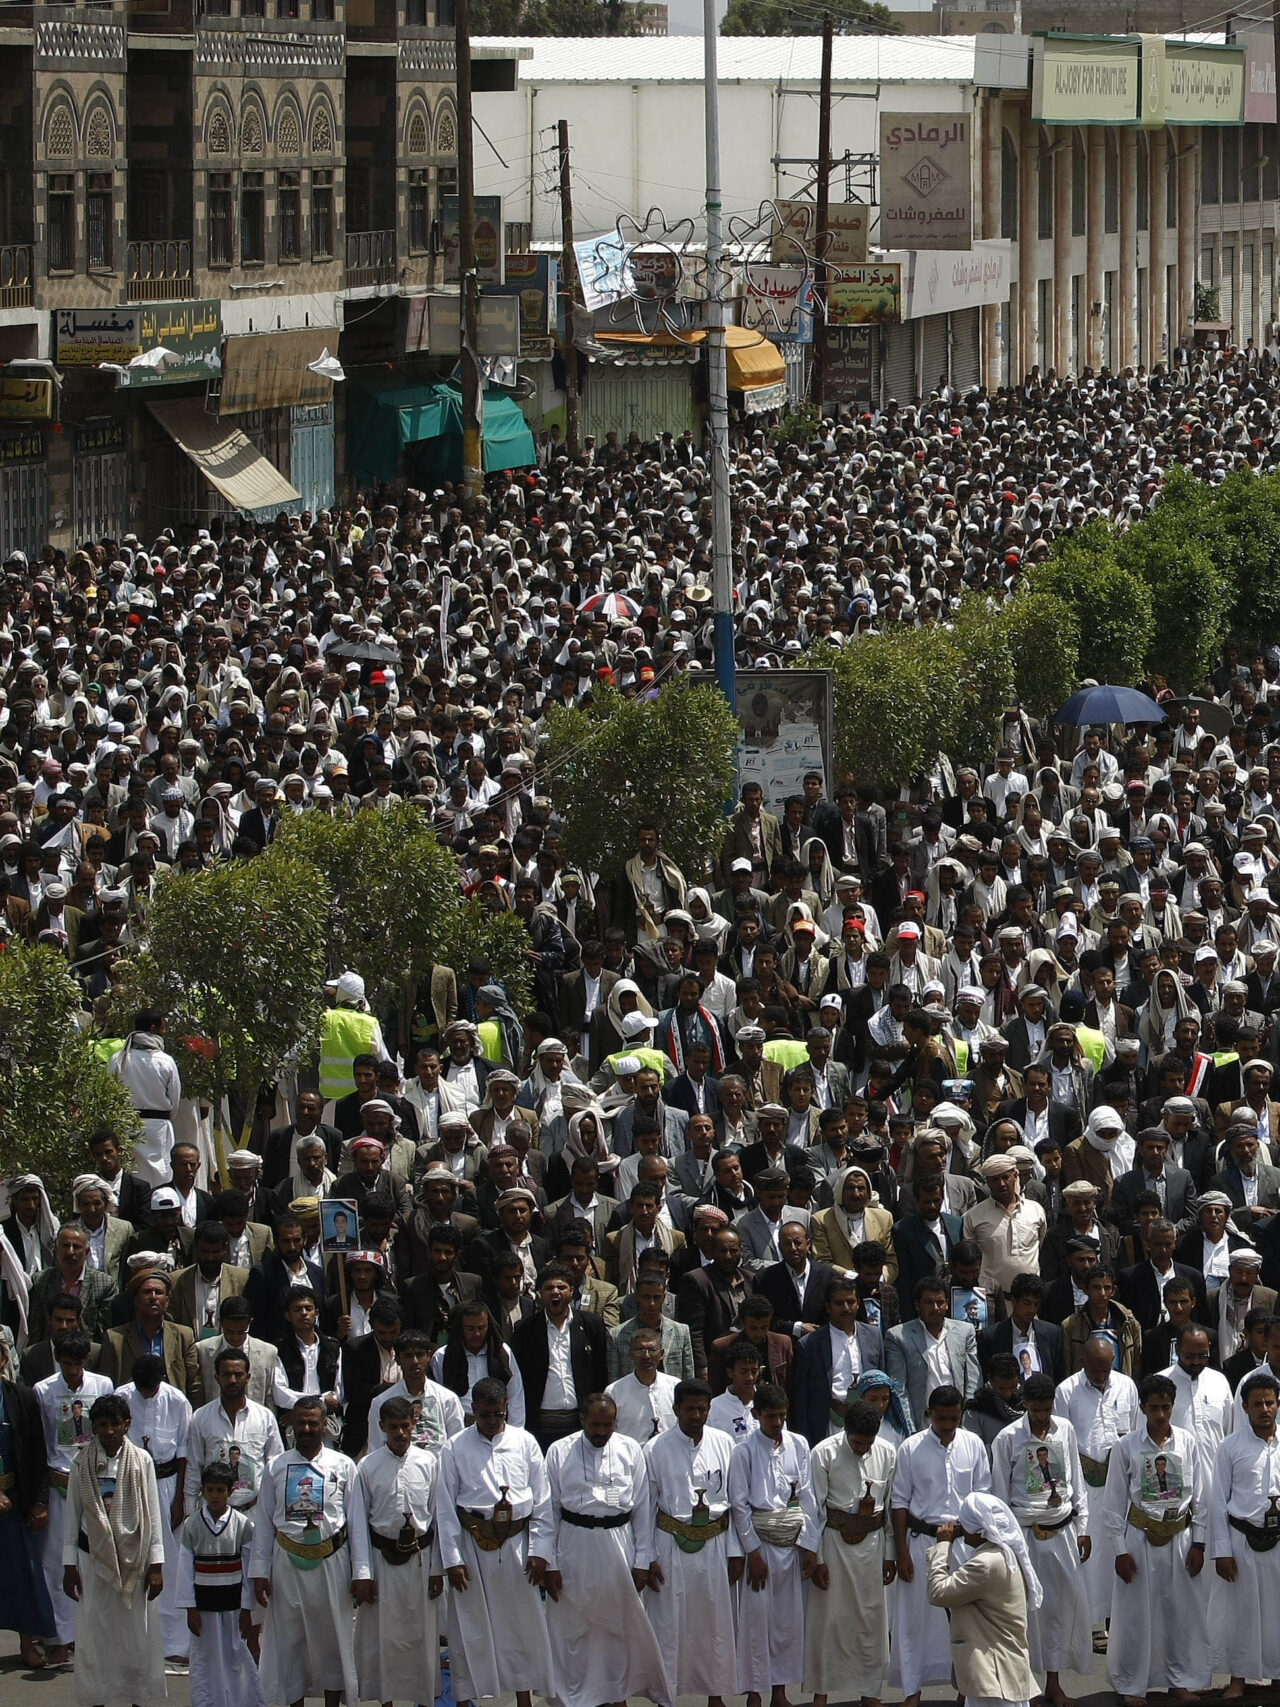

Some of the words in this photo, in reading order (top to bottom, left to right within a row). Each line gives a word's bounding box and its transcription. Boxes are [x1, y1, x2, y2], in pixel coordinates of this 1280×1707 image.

[1082, 65, 1094, 94] FOR
[1095, 66, 1128, 96] FURNITURE
[886, 123, 965, 151] الرمادي
[782, 202, 862, 236] صيلية
[886, 205, 965, 225] للمفروشات
[747, 274, 799, 305] صيدلية
[867, 269, 894, 286] مركز
[59, 311, 134, 338] مغسلة
